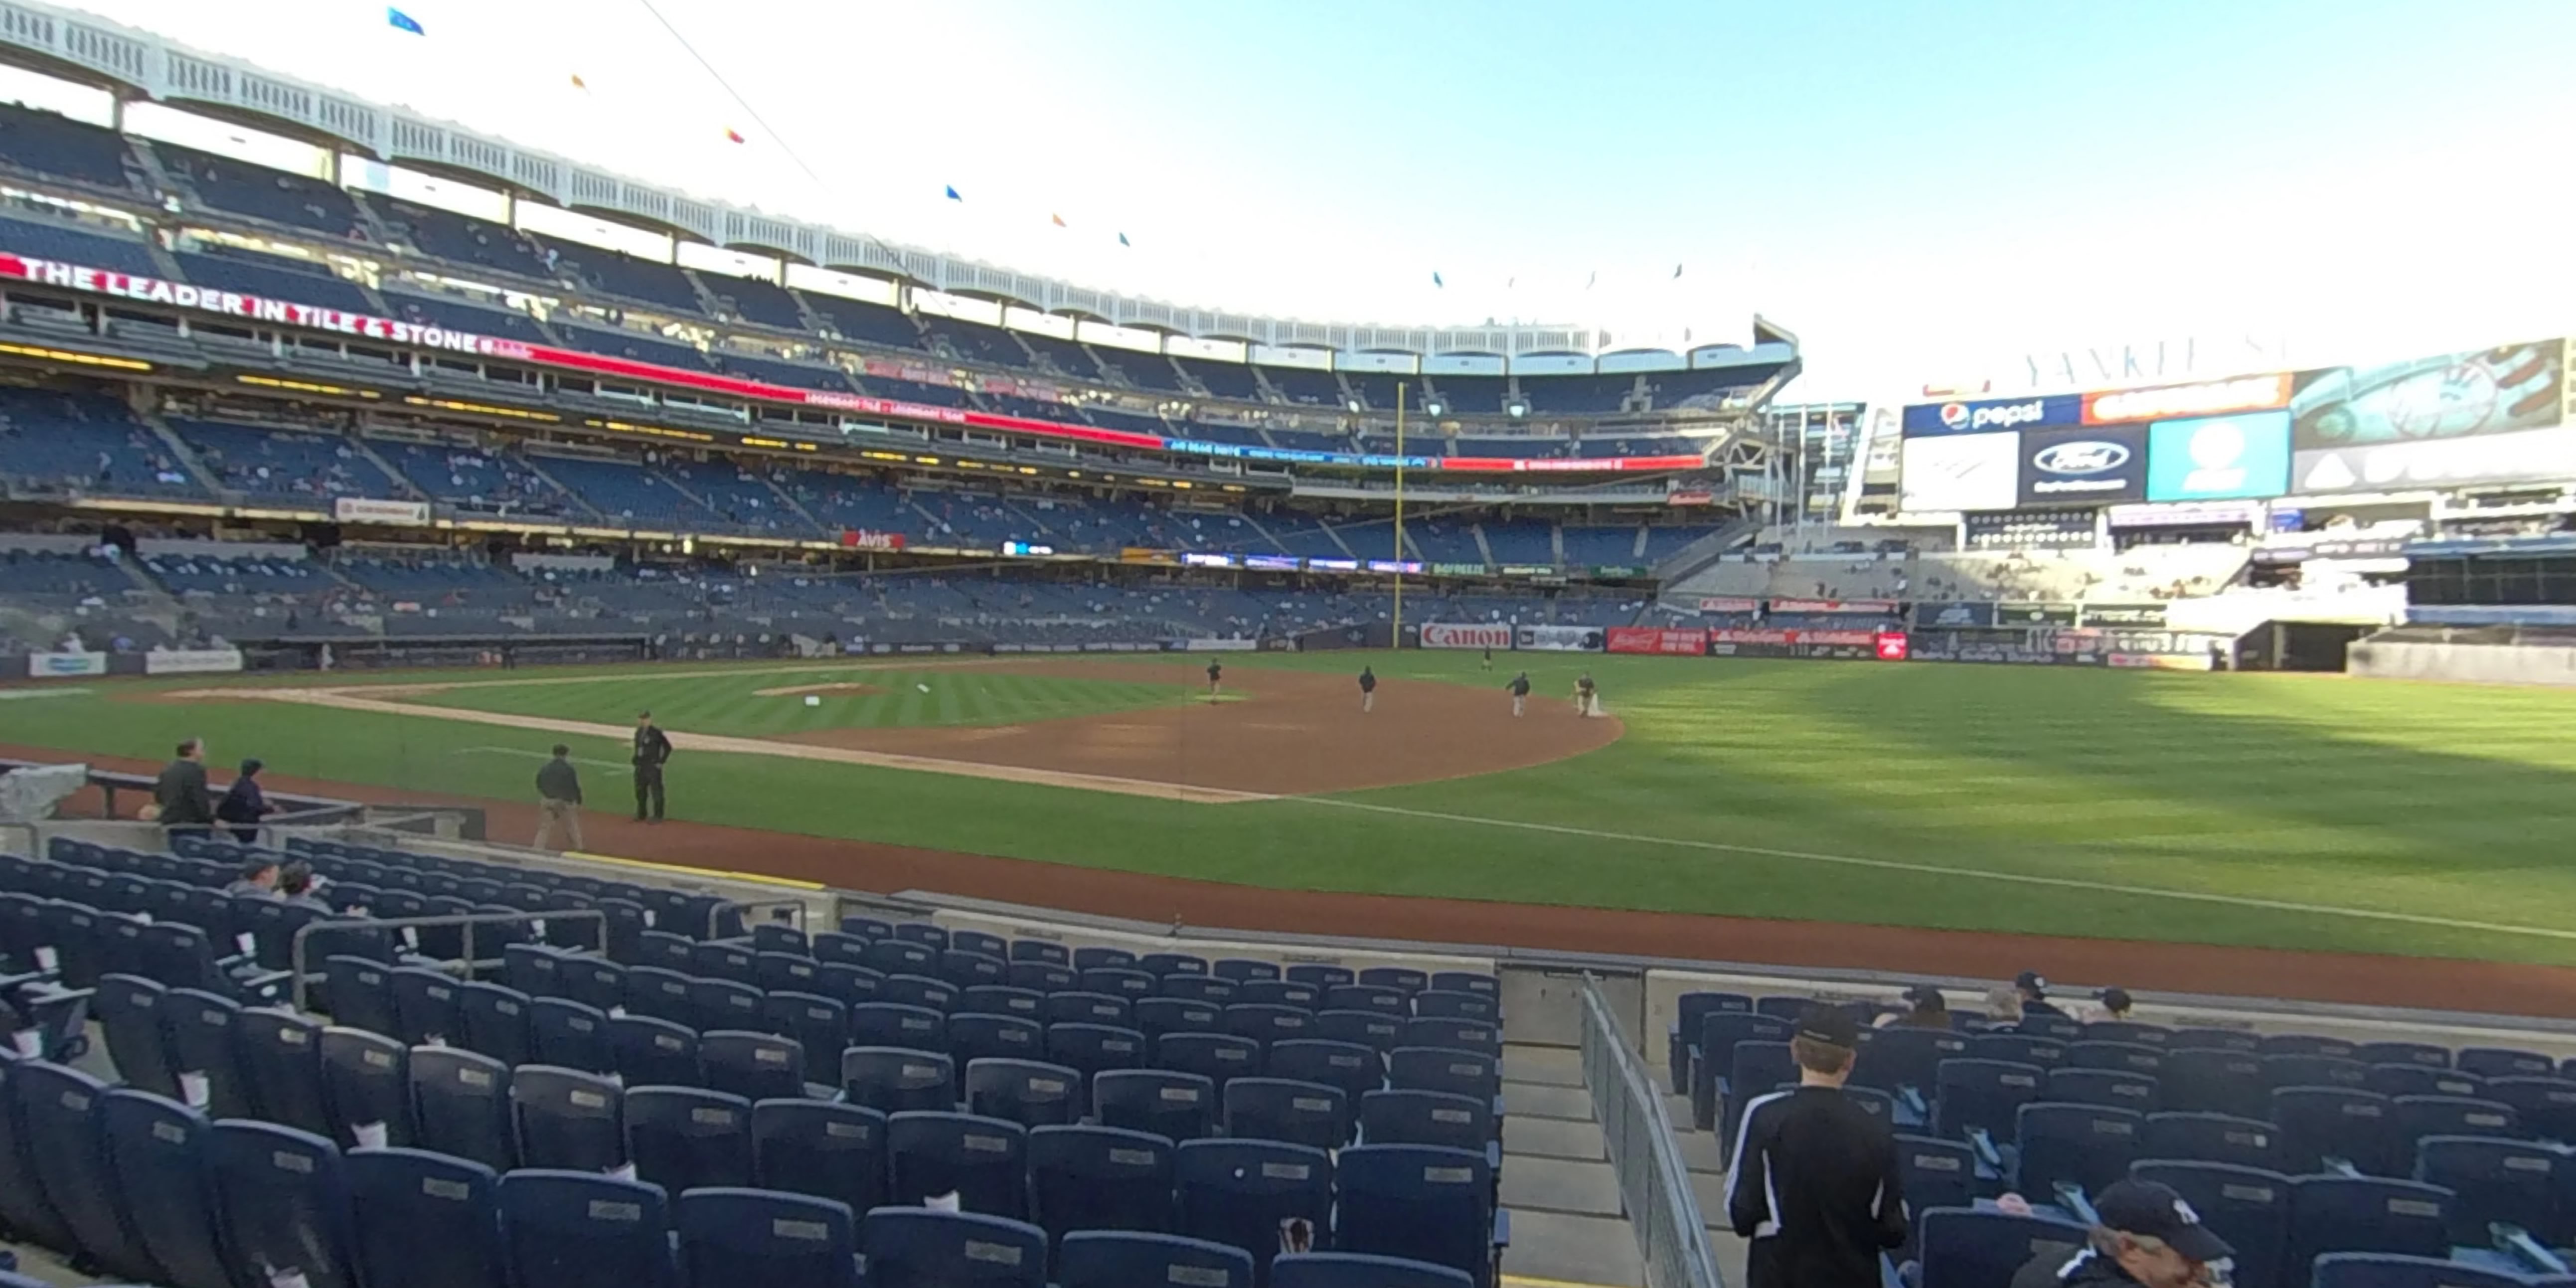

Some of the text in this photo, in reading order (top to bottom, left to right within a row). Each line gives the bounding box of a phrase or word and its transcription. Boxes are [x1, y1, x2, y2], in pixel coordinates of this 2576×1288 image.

[20, 257, 94, 291] THE
[106, 271, 243, 316] LEADER
[253, 298, 288, 323] IN
[295, 304, 356, 333] TILE
[363, 318, 385, 338] &
[391, 323, 476, 353] STONE
[1972, 400, 2043, 429] pepsi
[857, 532, 891, 548] AVIS
[1424, 626, 1509, 645] Canon
